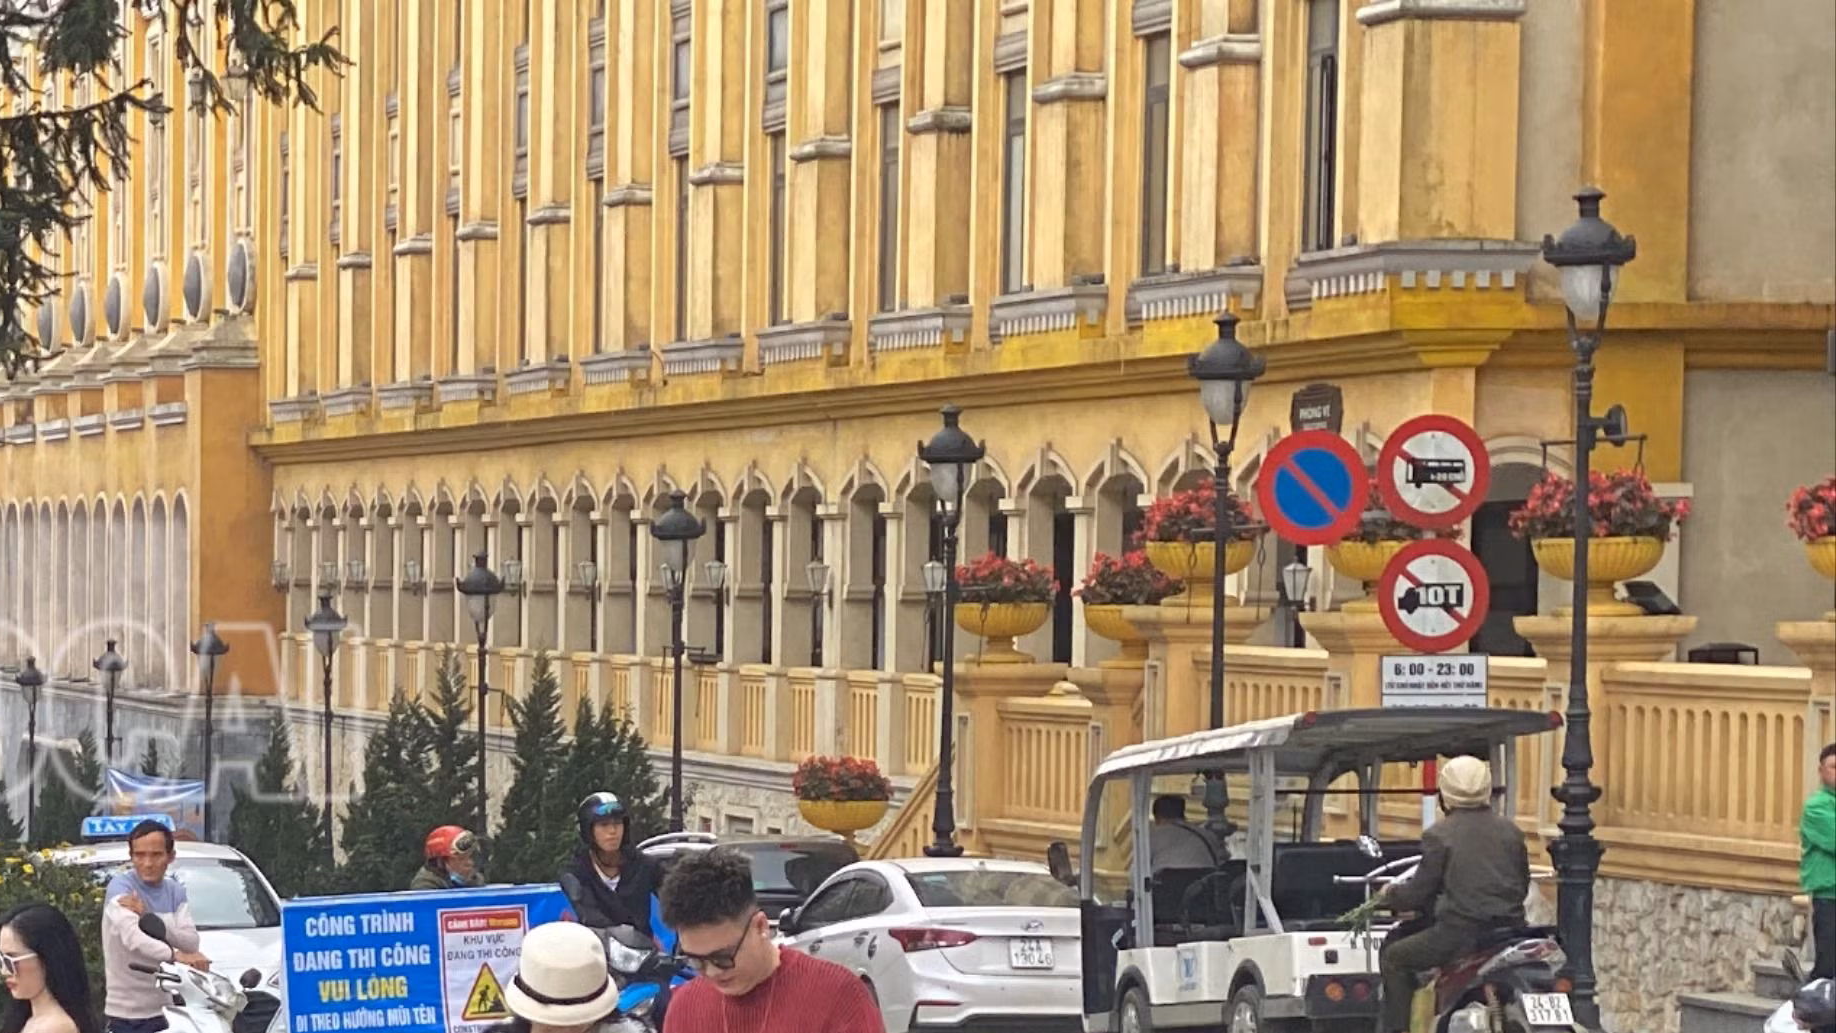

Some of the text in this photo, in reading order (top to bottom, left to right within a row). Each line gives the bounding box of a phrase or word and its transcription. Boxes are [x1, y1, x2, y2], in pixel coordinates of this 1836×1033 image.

[1415, 585, 1461, 605] 10T
[1409, 663, 1424, 676] 00
[1459, 663, 1474, 676] 00
[305, 909, 414, 937] CÔNG TRÌNH
[463, 935, 483, 945] KHU
[293, 942, 431, 973] ĐANG THI CÔNG
[477, 948, 493, 959] THI
[318, 973, 408, 1003] VUI LÒNG
[295, 1003, 436, 1033] ĐI THEO HƯỚNG MŨI TÊN
